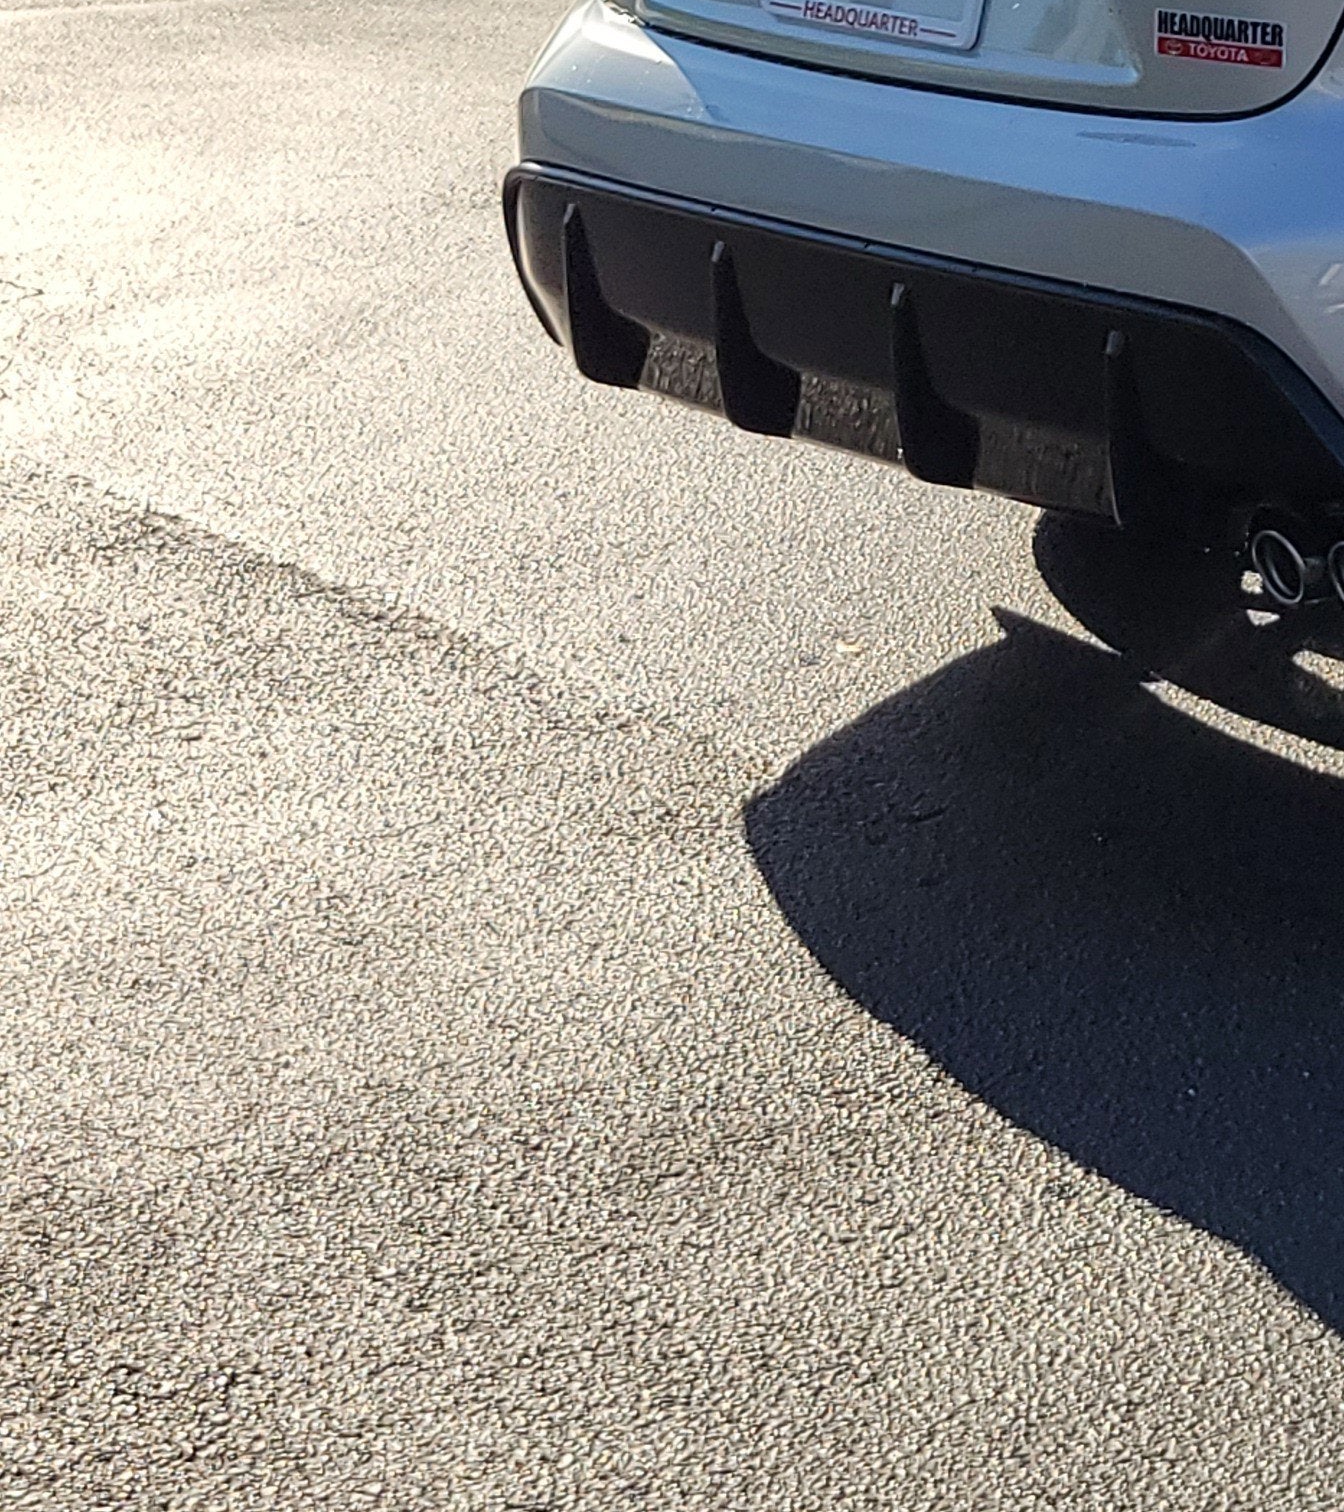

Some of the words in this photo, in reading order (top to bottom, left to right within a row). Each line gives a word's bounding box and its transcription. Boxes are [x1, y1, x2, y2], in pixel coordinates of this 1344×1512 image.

[803, 0, 918, 37] HEADQUARTER
[1157, 9, 1284, 48] HEADQUARTER
[1187, 42, 1250, 62] TOYOTA
